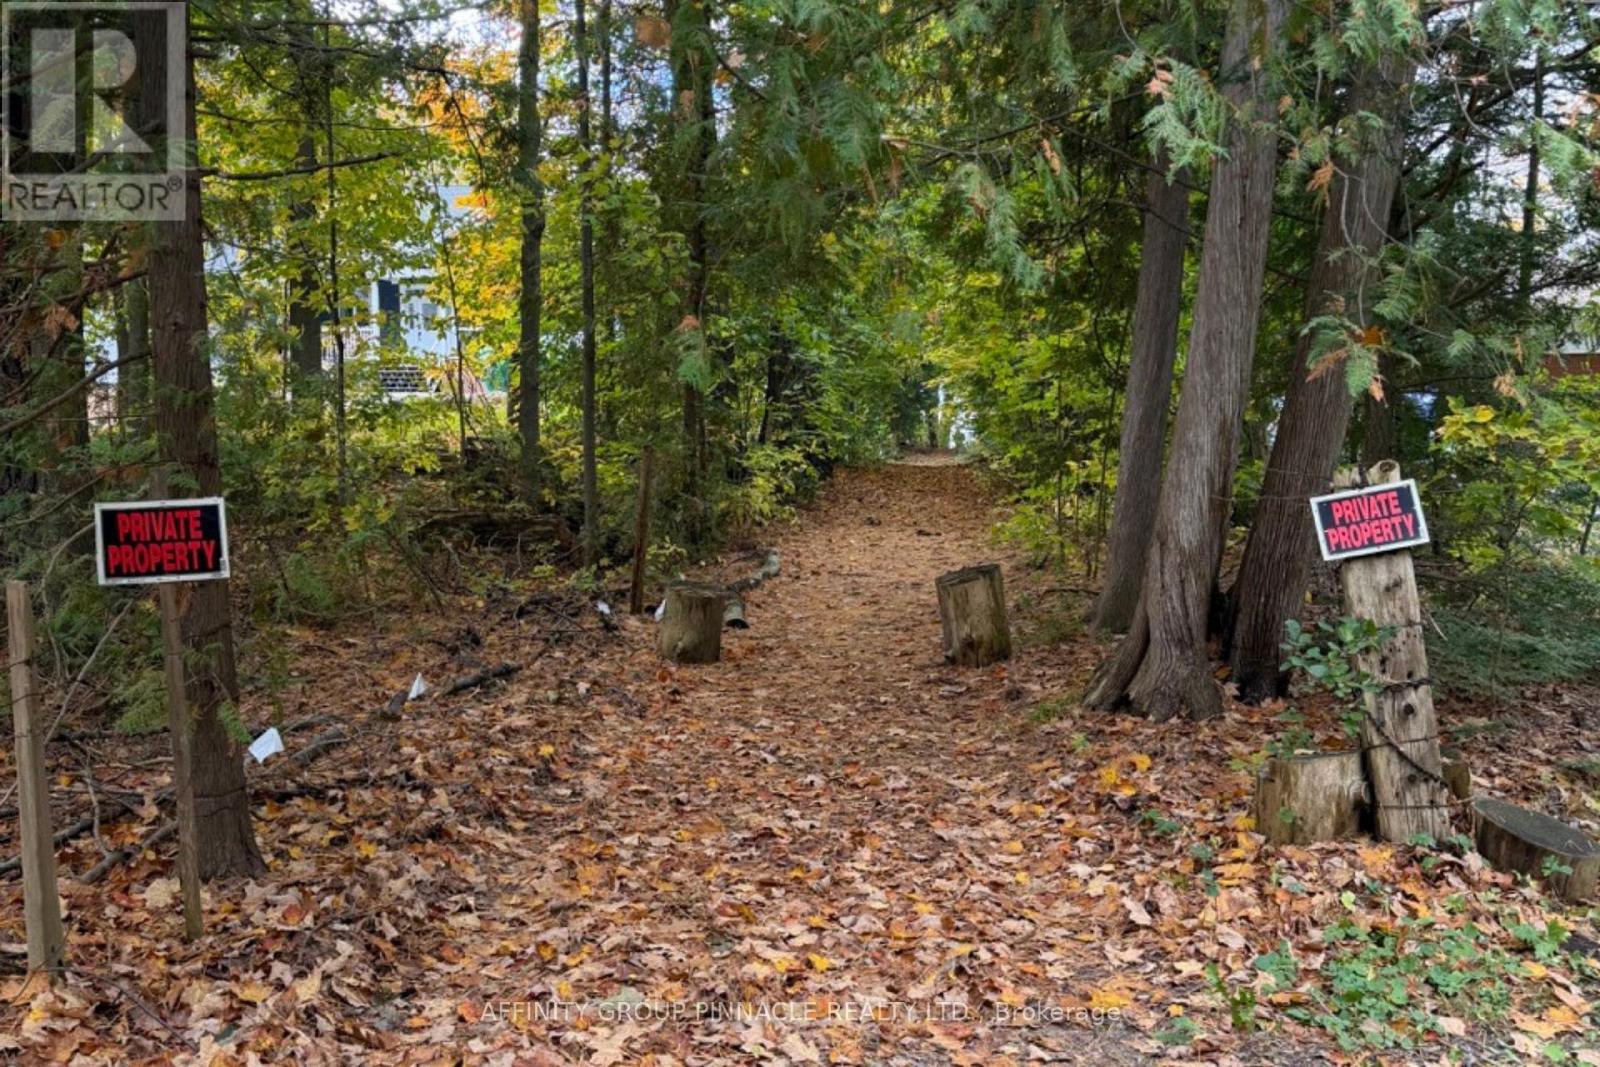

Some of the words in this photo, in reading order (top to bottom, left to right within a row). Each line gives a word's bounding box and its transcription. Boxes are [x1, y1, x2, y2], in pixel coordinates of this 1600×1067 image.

[116, 509, 202, 541] PRIVATE
[1331, 491, 1401, 525] PRIVATE
[1327, 513, 1414, 551] PROPERTY
[107, 540, 215, 574] PROPERTY
